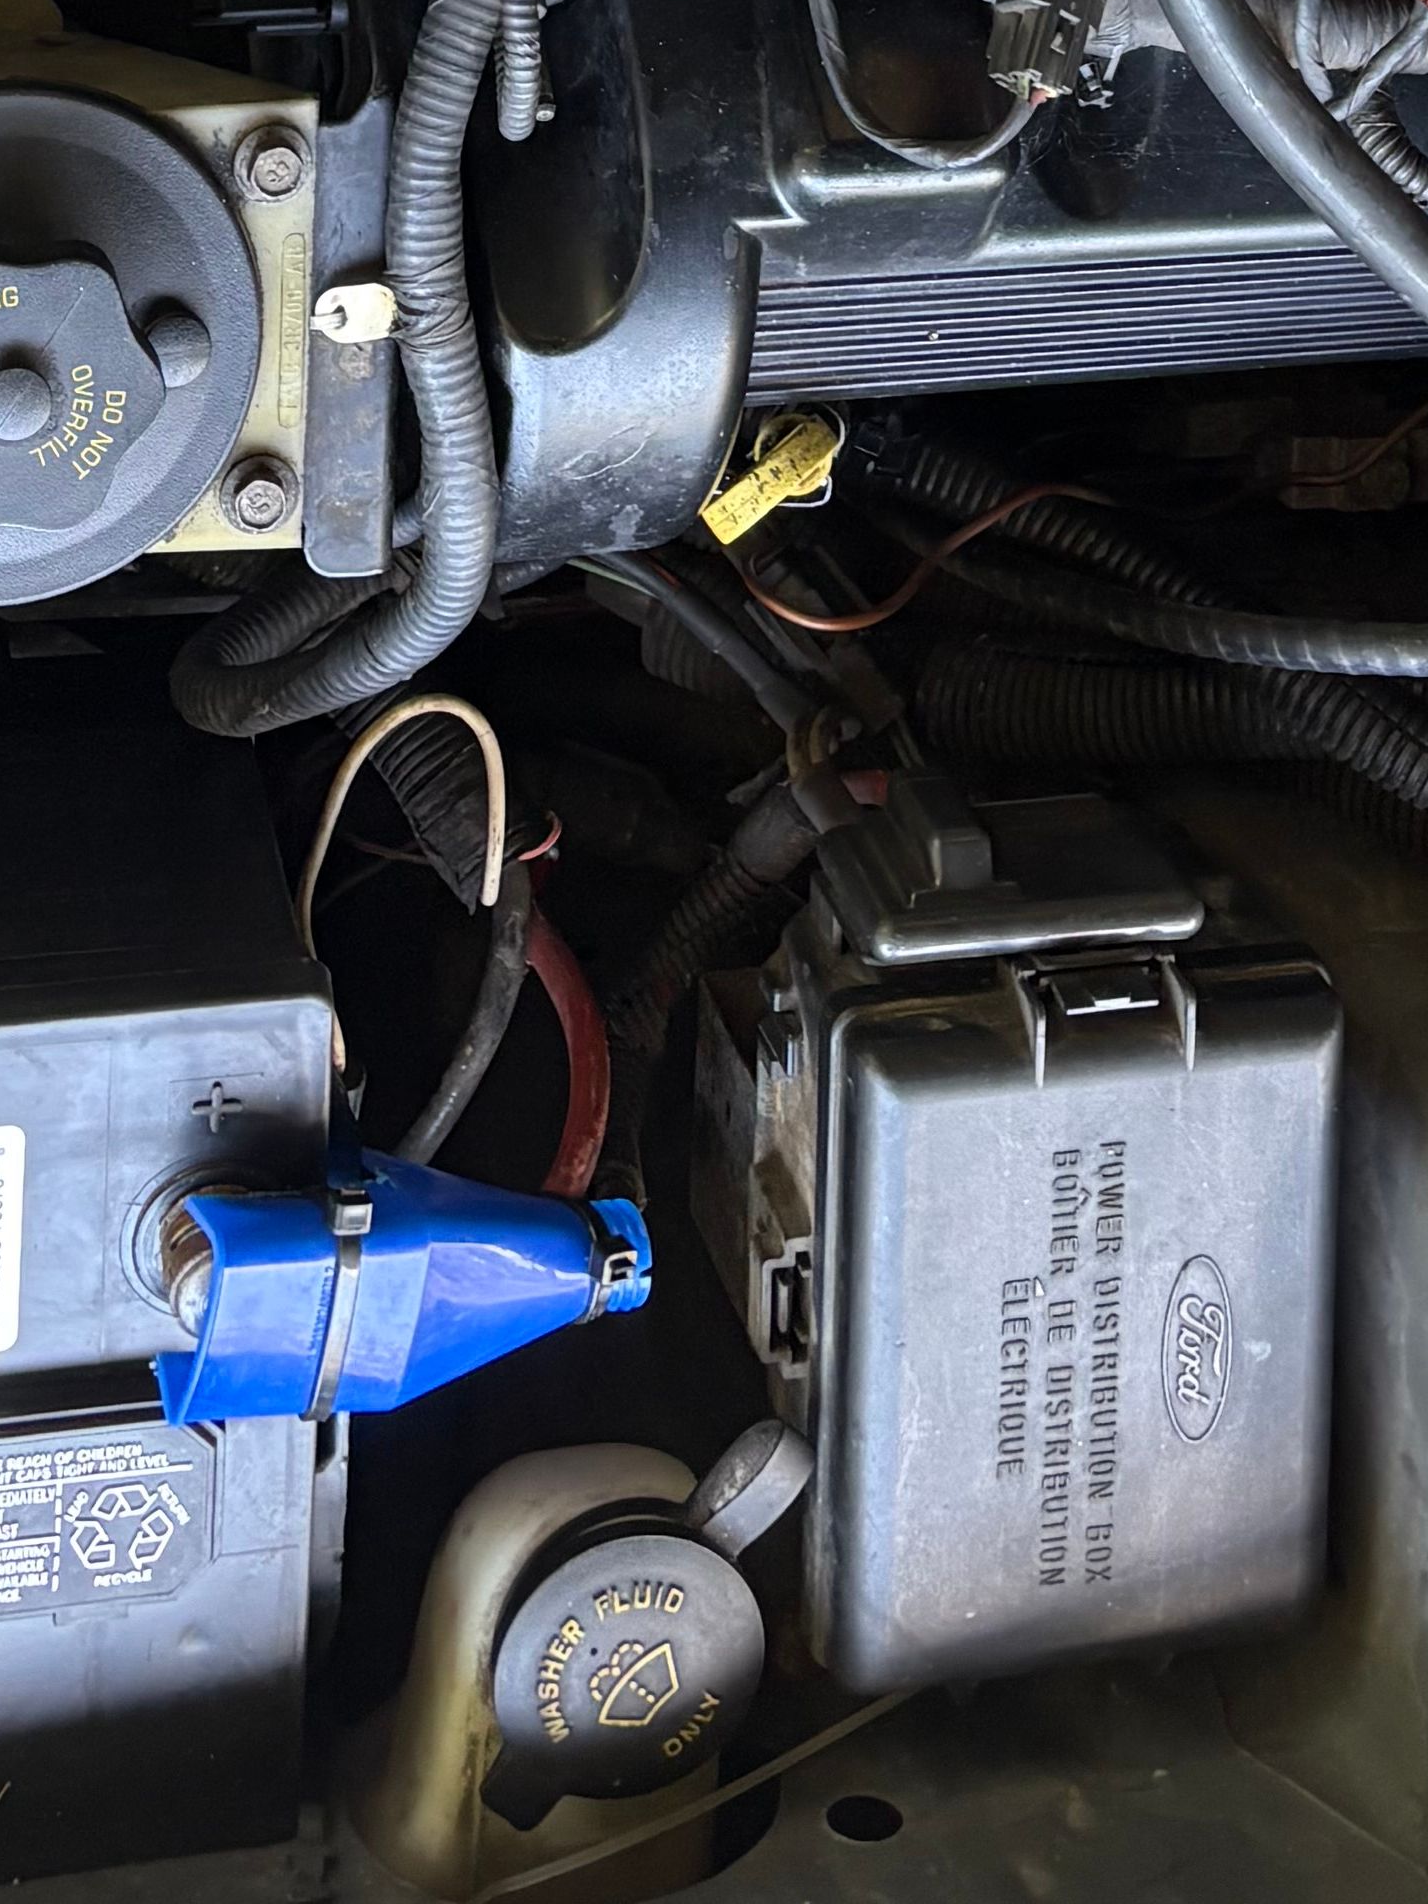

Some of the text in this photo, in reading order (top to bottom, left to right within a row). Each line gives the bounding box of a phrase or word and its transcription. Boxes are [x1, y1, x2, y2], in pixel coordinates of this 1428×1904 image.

[28, 364, 95, 467] OVERFILL
[72, 390, 127, 481] DO NOT
[1047, 1300, 1076, 1343] DE
[1085, 1141, 1126, 1584] POWER DISTRIBUTION BOX
[1175, 1291, 1227, 1409] Ford
[130, 1454, 170, 1469] LEVEL
[1039, 1366, 1074, 1586] DISTRIBUTION
[538, 1584, 684, 1743] WASHER FLUID
[663, 1690, 720, 1757] ONLY
